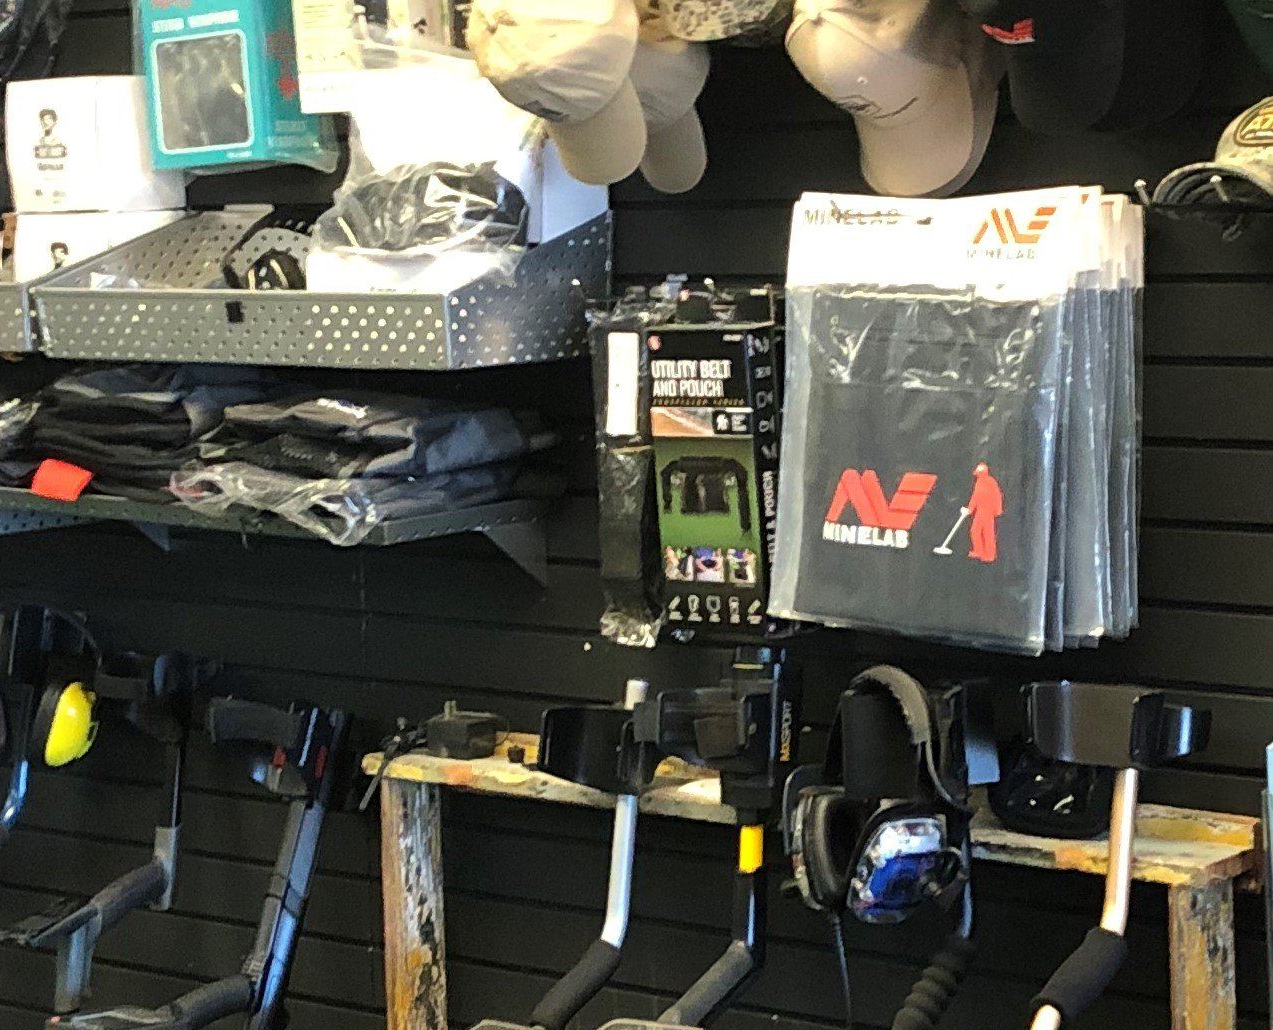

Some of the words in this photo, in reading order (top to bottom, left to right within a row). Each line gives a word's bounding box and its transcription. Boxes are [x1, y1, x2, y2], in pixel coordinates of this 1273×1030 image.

[651, 360, 697, 379] UTILITY
[700, 359, 732, 379] BELT
[652, 379, 676, 398] AND
[679, 379, 725, 398] POUCH
[822, 521, 911, 549] MINELAB
